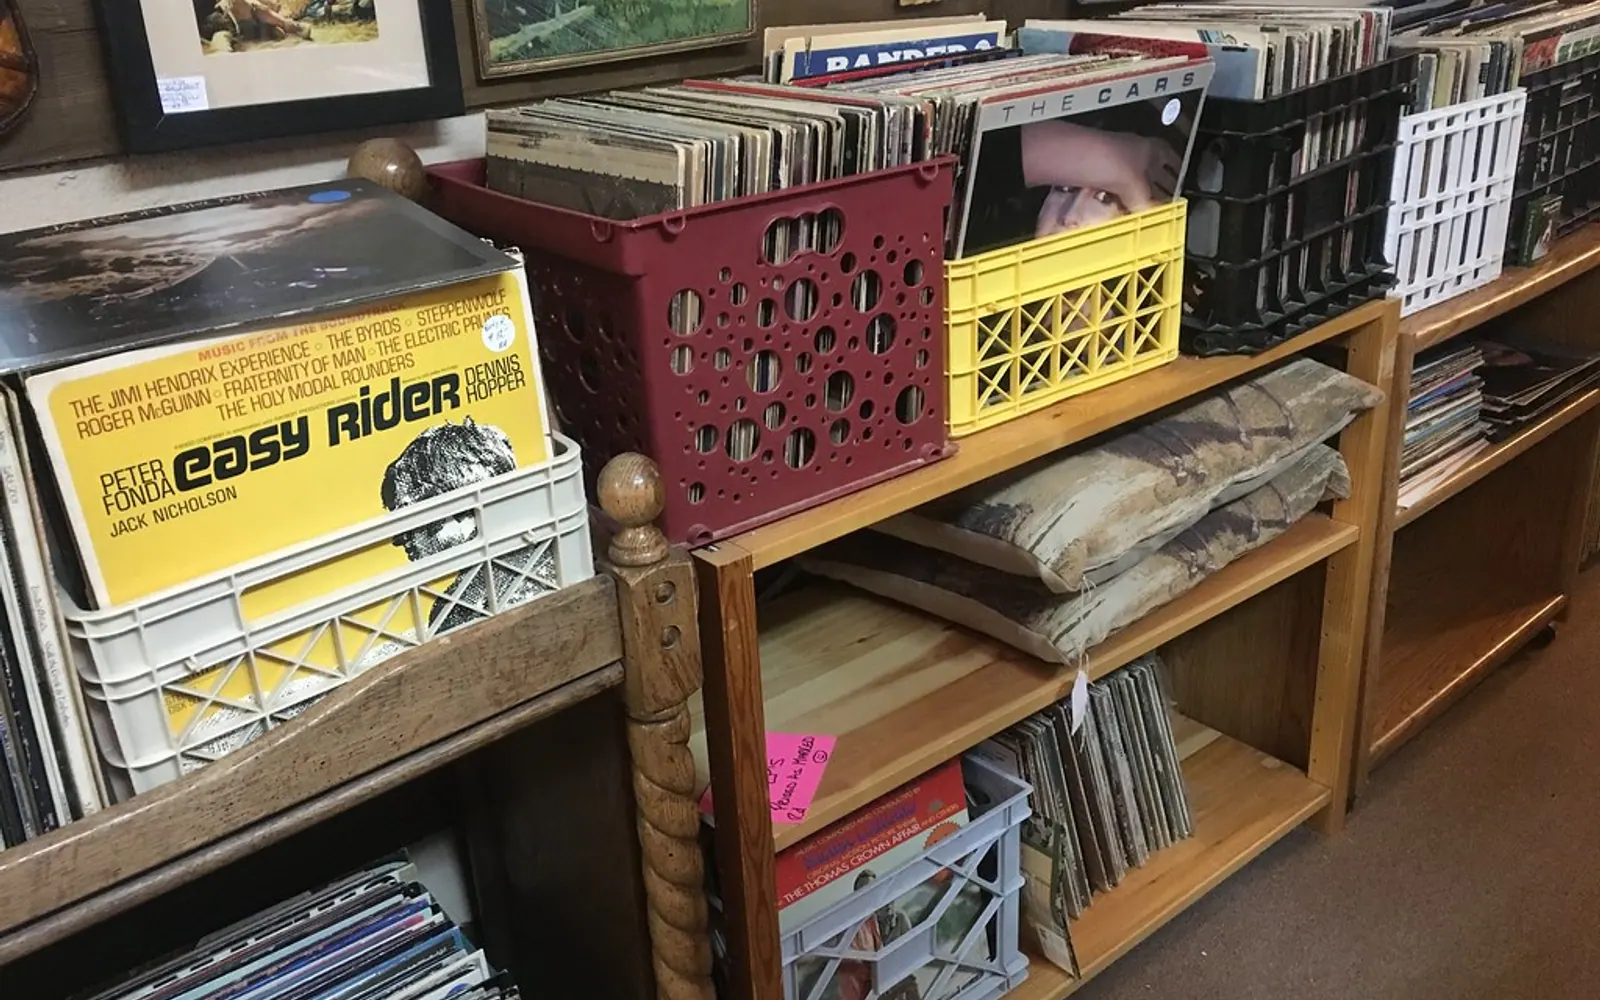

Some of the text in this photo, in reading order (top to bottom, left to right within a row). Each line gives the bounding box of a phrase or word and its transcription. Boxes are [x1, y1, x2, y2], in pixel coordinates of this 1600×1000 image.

[1003, 71, 1195, 123] THE CARS
[69, 288, 507, 419] THE JIMI HENDRIX EXPERIENCE THE BYRDS STEPPENWOLF
[198, 341, 245, 362] MUSIC
[292, 324, 317, 336] THE
[76, 410, 135, 440] ROGER
[138, 387, 212, 420] McGUINN
[223, 361, 311, 399] FRATERNITY
[311, 357, 330, 376] OF
[333, 348, 367, 369] MAN
[375, 338, 402, 358] THE
[404, 320, 461, 350] ELECTRIC
[216, 401, 248, 422] THE
[251, 387, 286, 412] HOLY
[288, 376, 342, 403] MODAL
[342, 353, 415, 386] ROUNDERS
[464, 354, 521, 386] DENNIS
[466, 370, 526, 404] HOPPER
[100, 459, 166, 495] PETER
[173, 415, 310, 492] easy
[102, 478, 175, 516] FONDA
[110, 485, 238, 538] JACK NICHOLSON
[783, 888, 806, 903] THE
[804, 862, 850, 893] THOMAS
[850, 839, 891, 867] CROWN
[892, 822, 921, 846] AFFAIR
